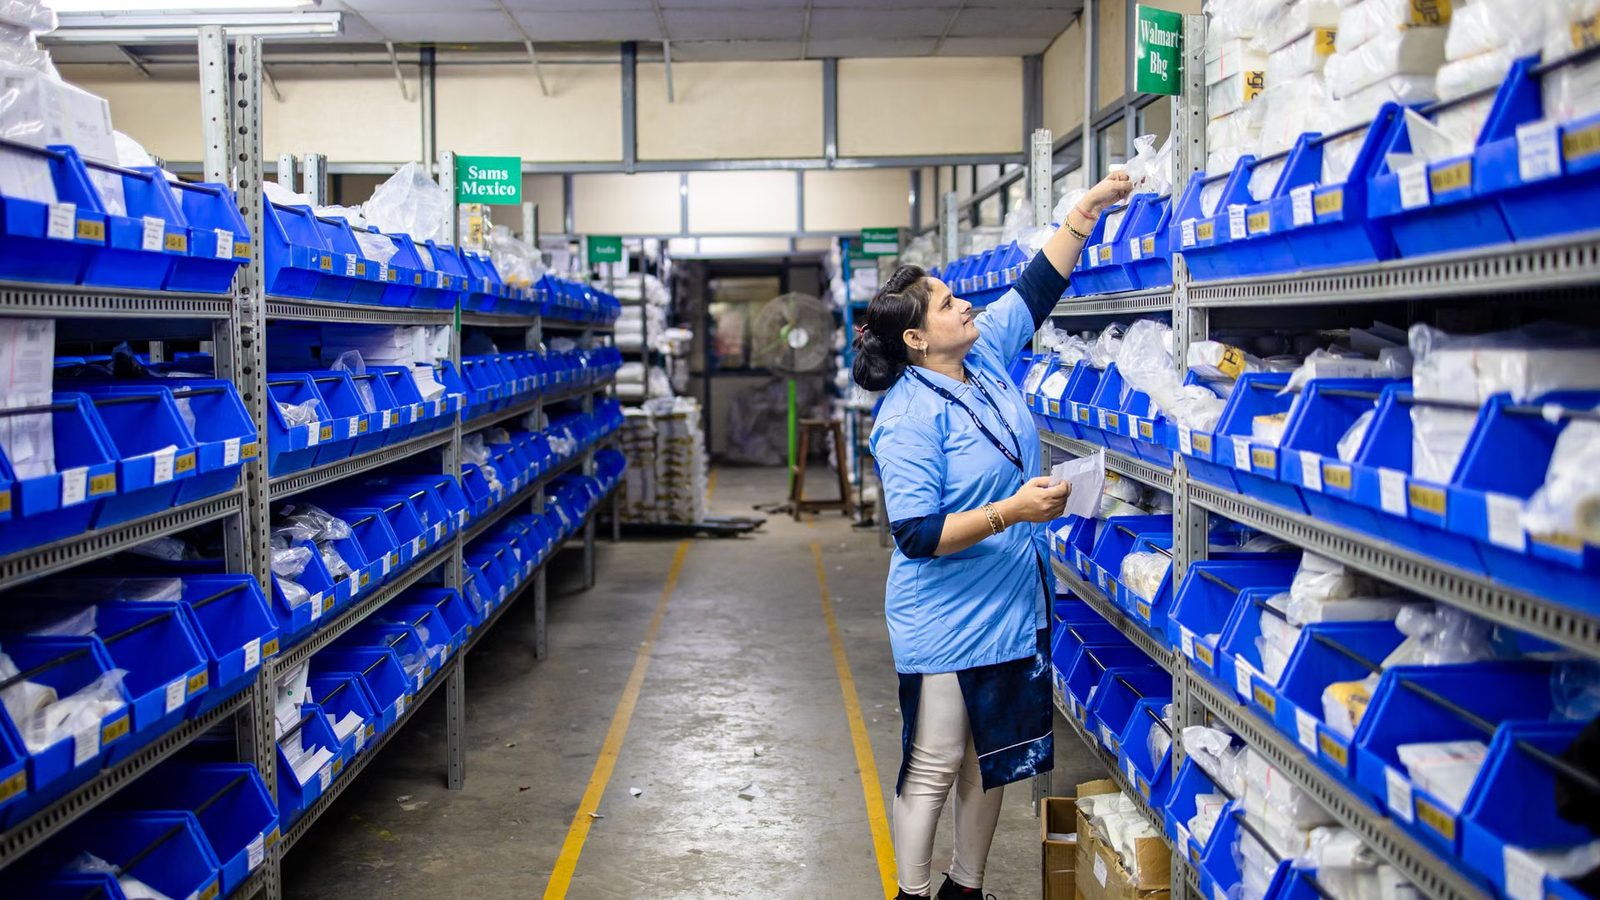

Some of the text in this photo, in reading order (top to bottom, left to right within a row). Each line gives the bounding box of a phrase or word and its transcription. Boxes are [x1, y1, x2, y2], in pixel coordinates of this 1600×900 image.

[1141, 19, 1178, 48] Walmart
[1150, 51, 1168, 81] Bhg
[468, 166, 508, 180] Sams
[462, 181, 515, 195] Mexico
